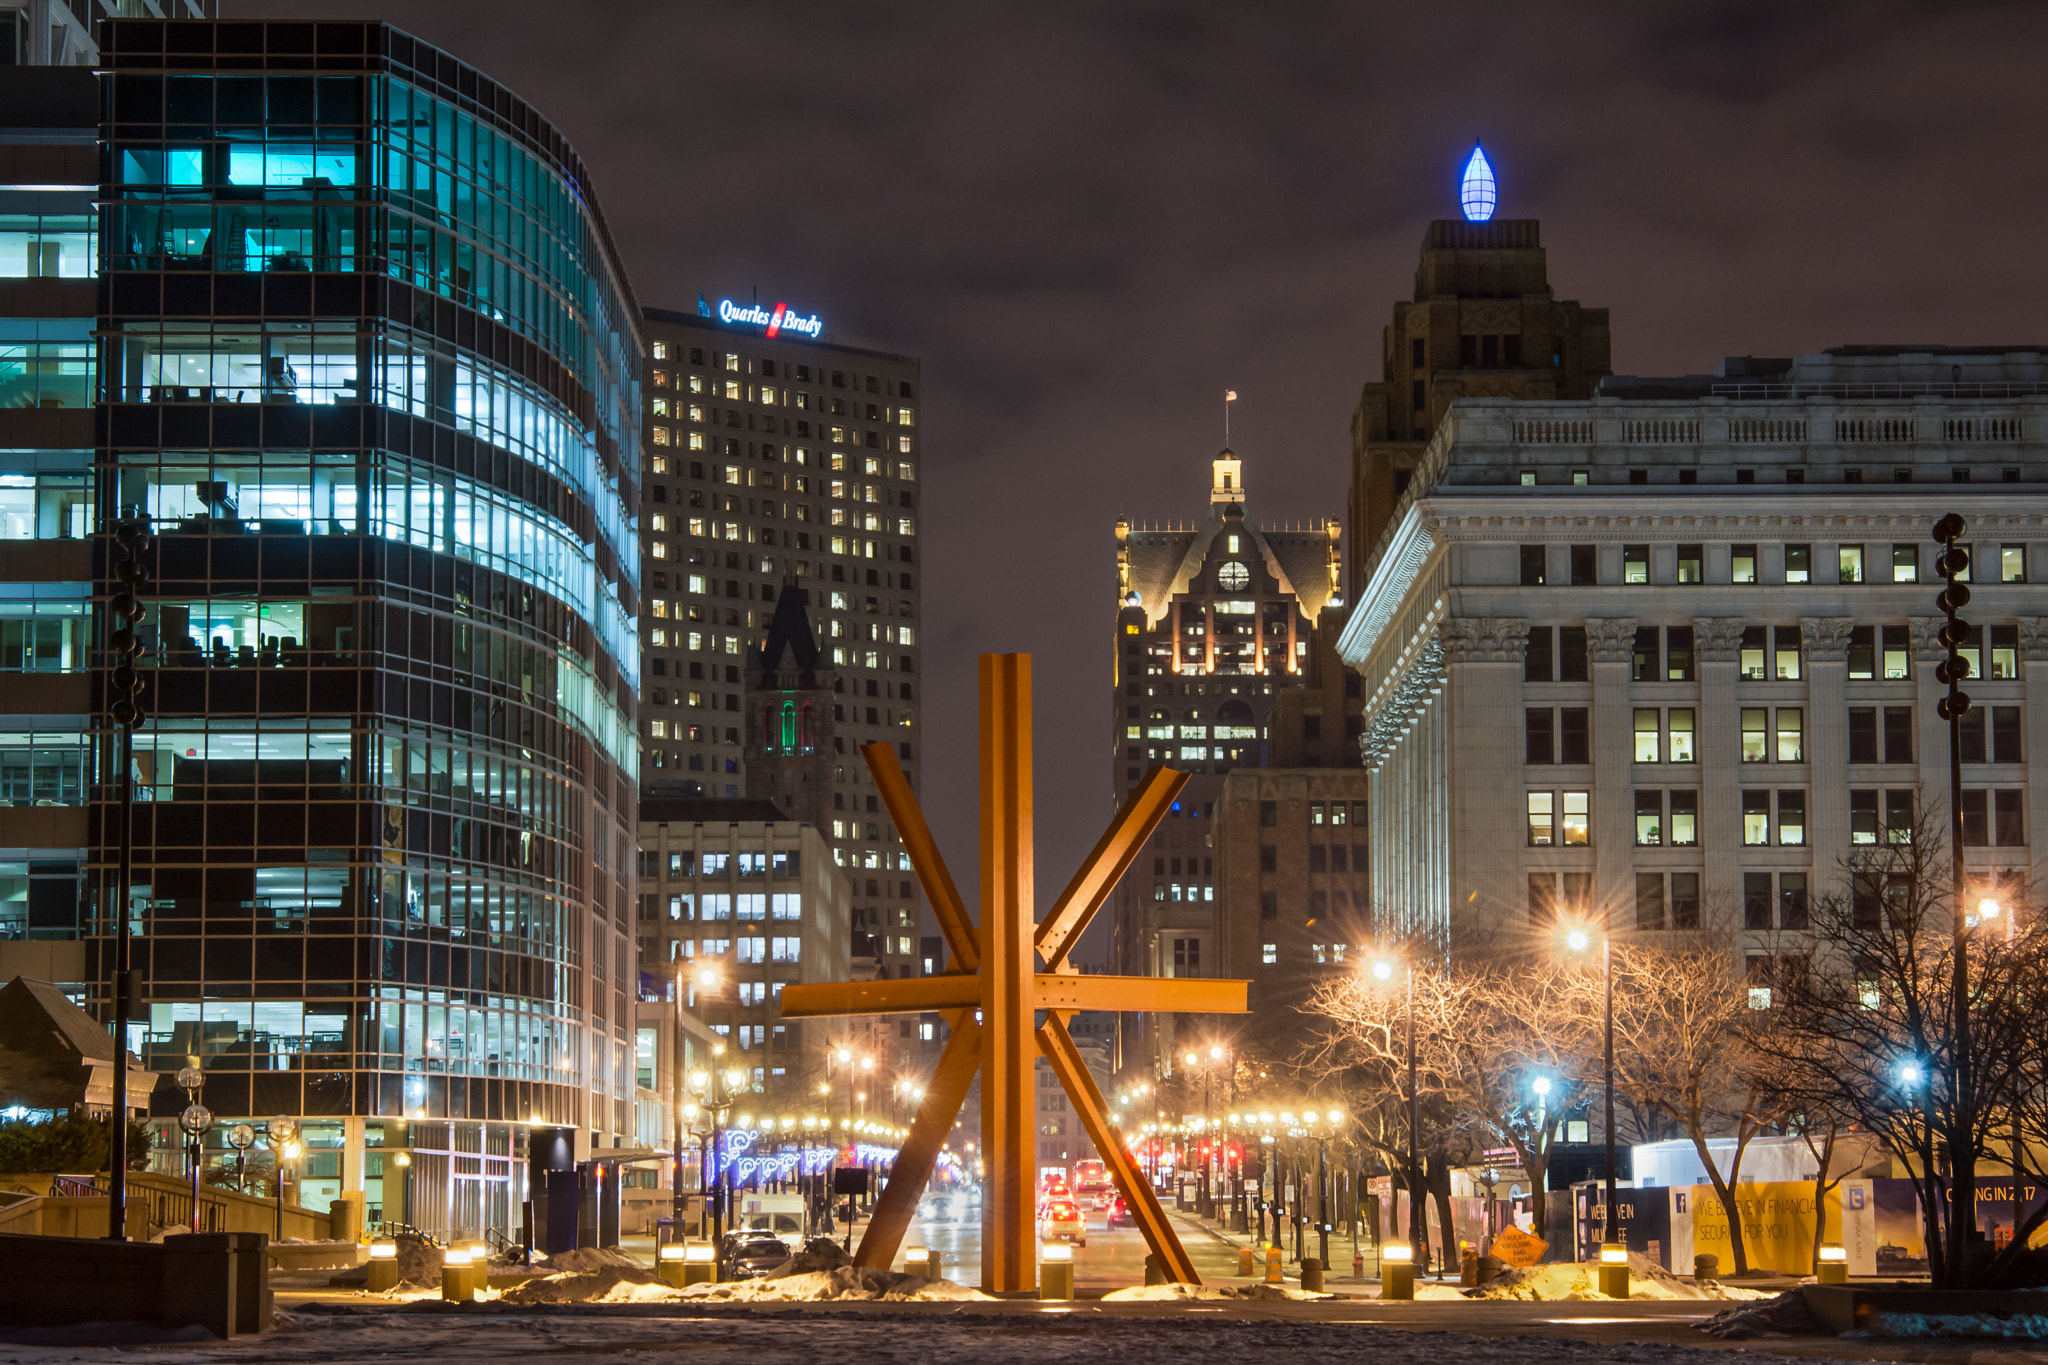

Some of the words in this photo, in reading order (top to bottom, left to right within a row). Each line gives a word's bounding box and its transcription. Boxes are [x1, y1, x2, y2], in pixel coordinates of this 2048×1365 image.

[720, 300, 770, 325] Quarles
[771, 313, 781, 327] &
[782, 310, 822, 338] Brady
[1946, 1187, 1992, 1202] CNG
[1994, 1187, 2007, 1200] IN
[2008, 1186, 2036, 1200] 217
[1699, 1200, 1714, 1216] WE
[1716, 1199, 1753, 1215] BEEVE
[1756, 1199, 1766, 1214] IN
[1768, 1199, 1817, 1214] FINANCIA
[1591, 1227, 1627, 1243] MILWEE
[1700, 1225, 1730, 1240] SECURI
[1744, 1224, 1764, 1240] FOR
[1766, 1223, 1788, 1239] YOU
